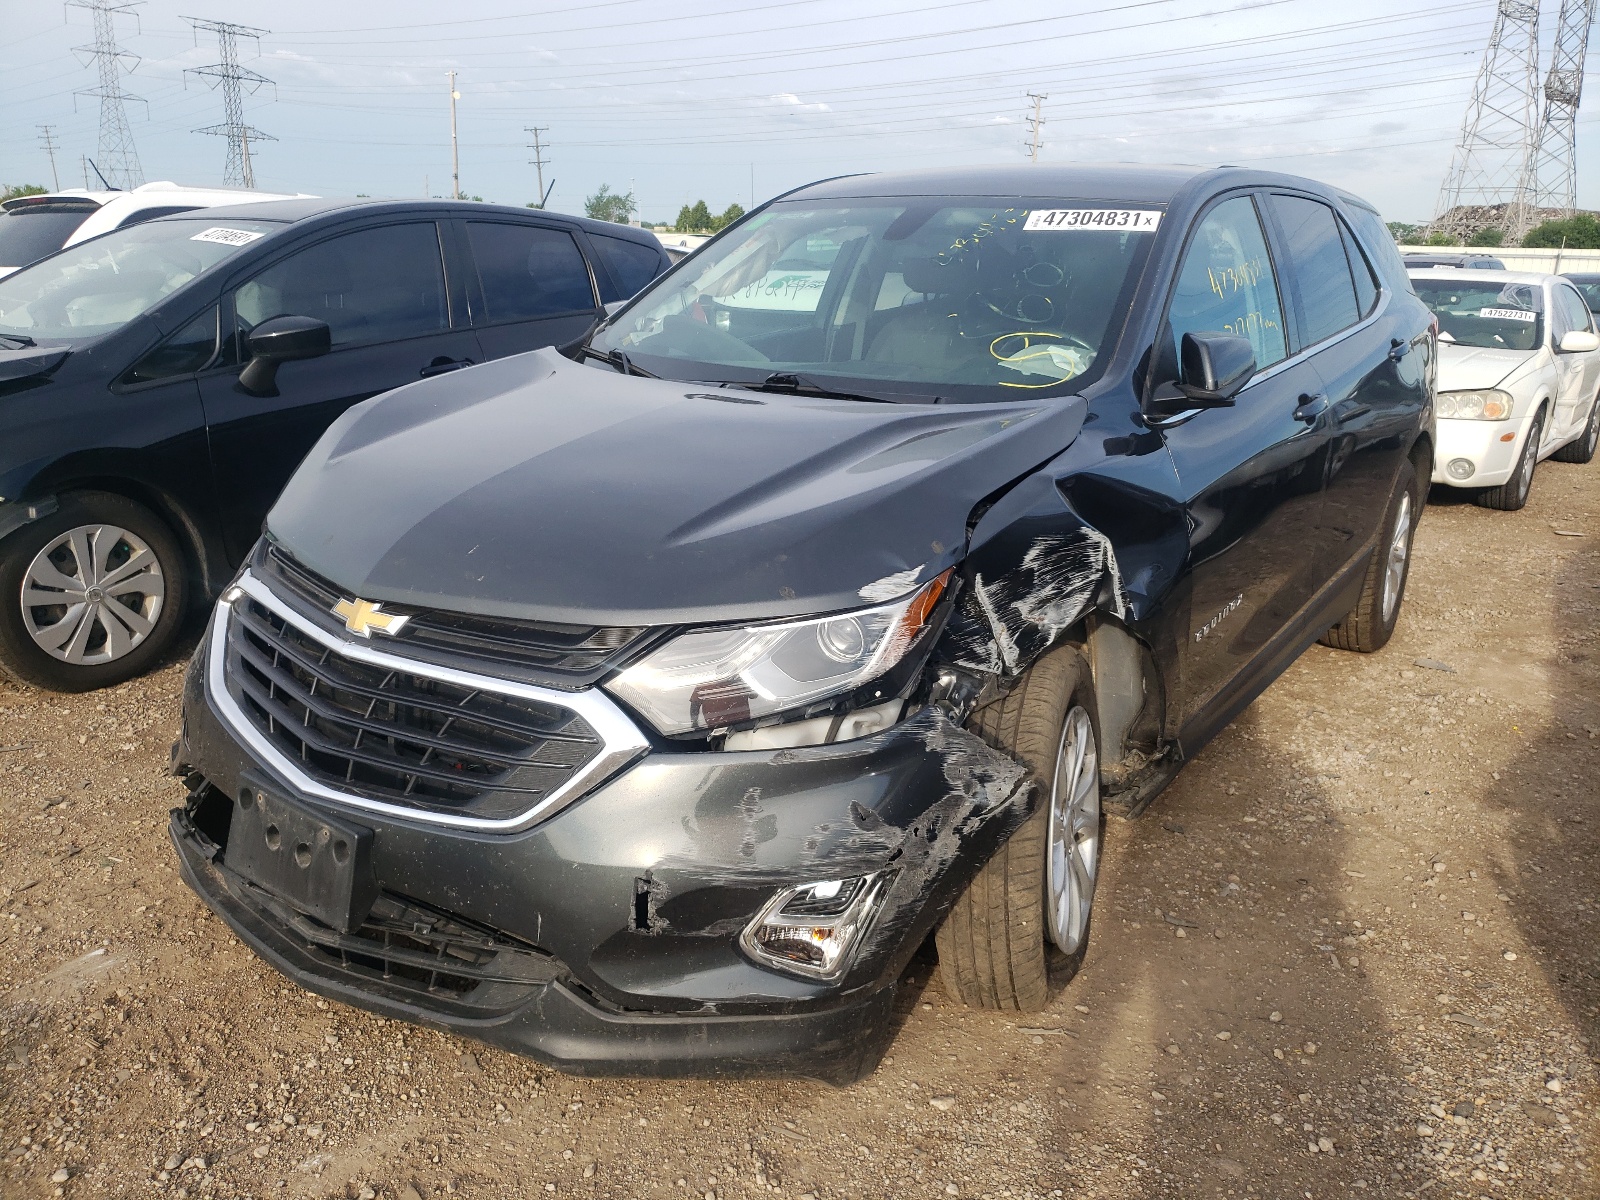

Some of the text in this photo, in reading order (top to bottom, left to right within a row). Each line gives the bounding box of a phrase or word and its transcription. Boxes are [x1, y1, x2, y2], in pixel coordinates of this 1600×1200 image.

[1043, 211, 1141, 226] 47304831
[1487, 309, 1528, 320] 47522731
[1195, 593, 1243, 642] EQUINOX
